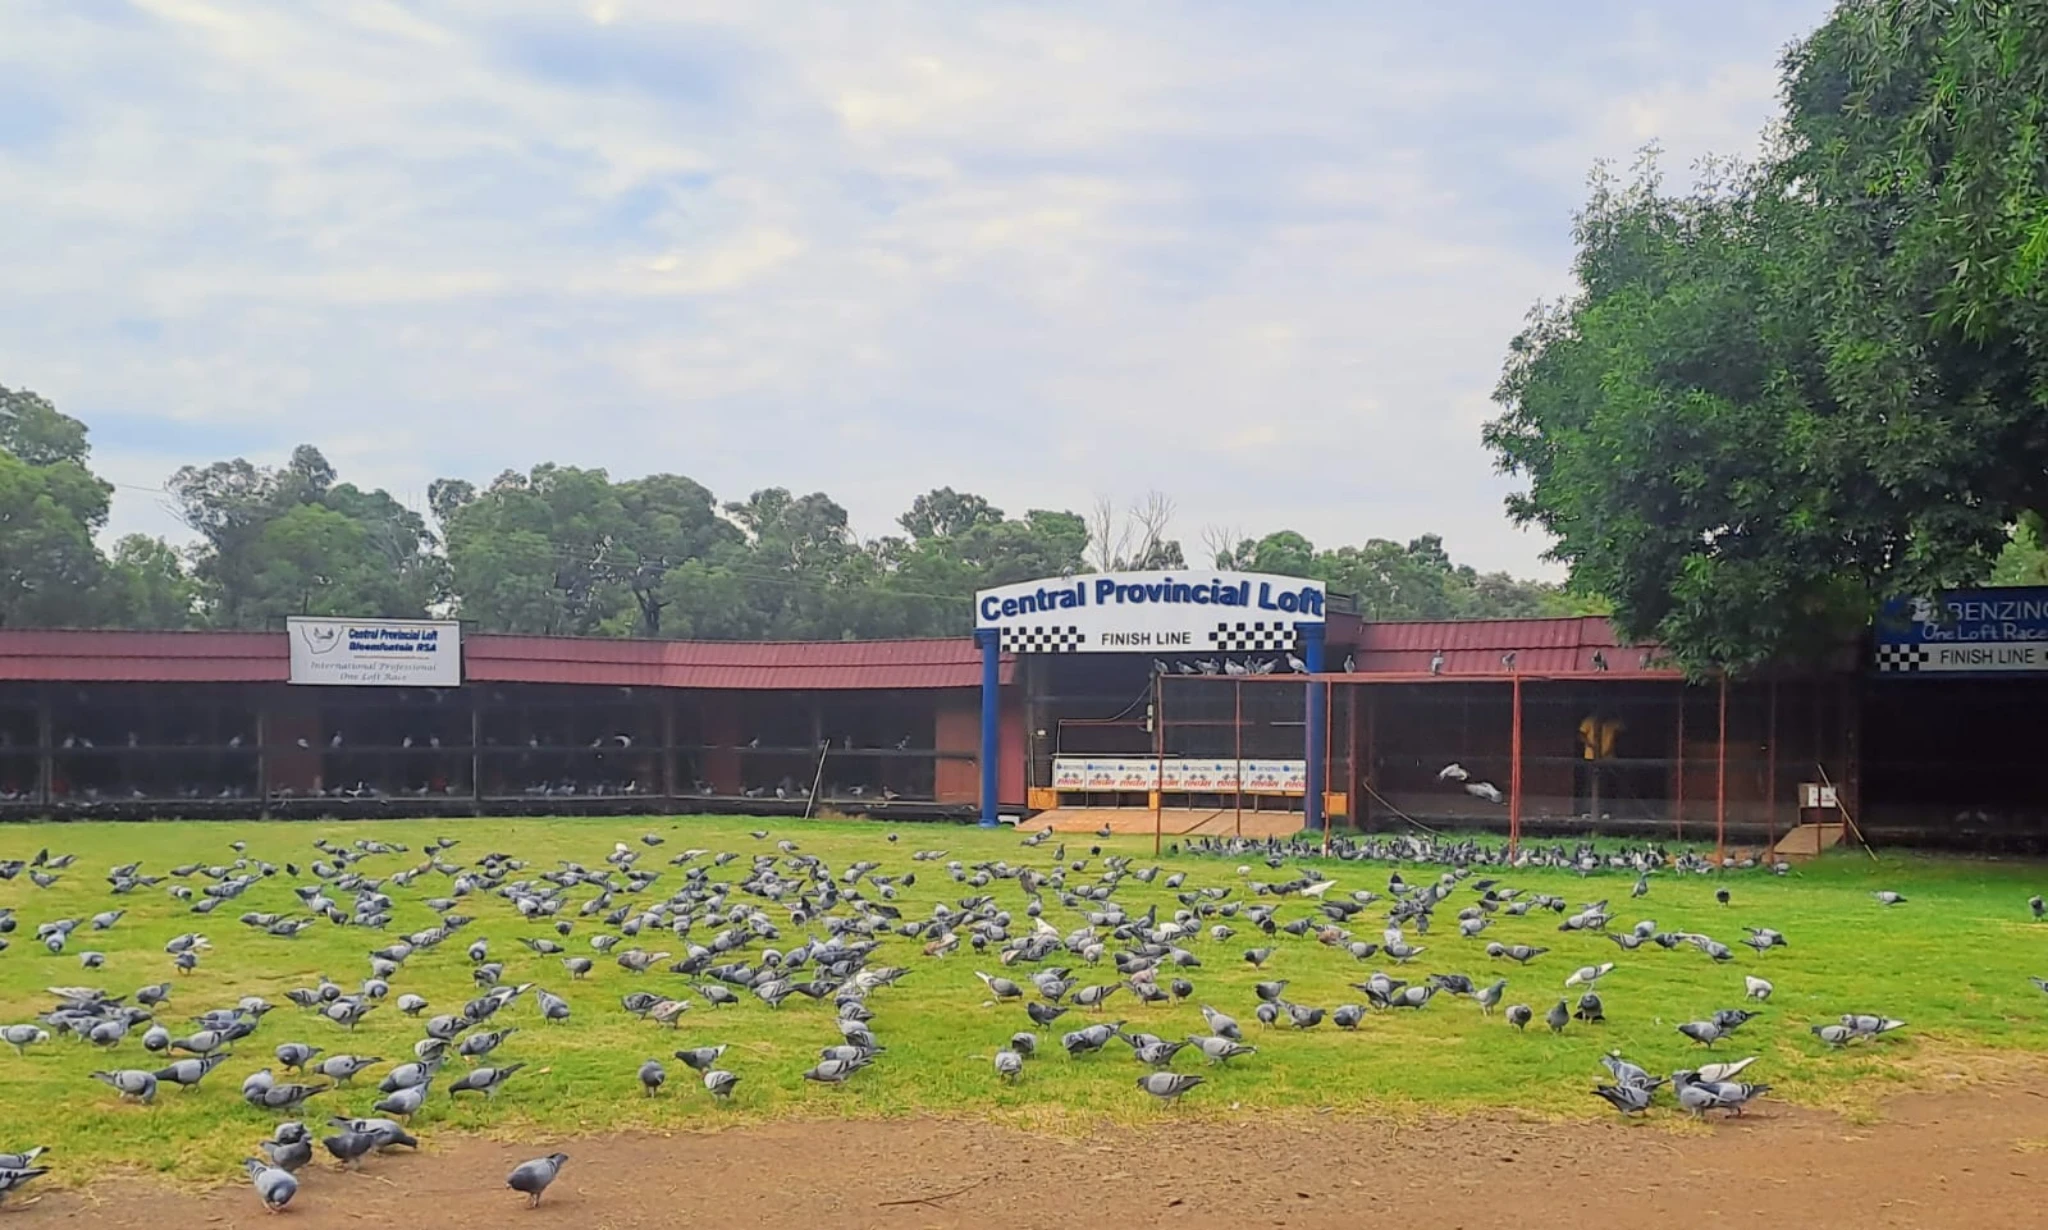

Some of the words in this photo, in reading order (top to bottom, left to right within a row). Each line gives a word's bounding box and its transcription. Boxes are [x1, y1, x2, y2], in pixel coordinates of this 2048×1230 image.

[980, 582, 1085, 621] Central
[1095, 578, 1250, 607] Provincial
[1258, 583, 1324, 617] Loft
[348, 628, 379, 639] Central
[380, 628, 420, 640] Provincial
[421, 630, 438, 641] Loft
[1923, 622, 1955, 640] One
[1957, 625, 1999, 640] Loft
[2003, 622, 2048, 640] Race
[1101, 633, 1151, 646] FINISH
[1157, 632, 1191, 645] LINE
[416, 642, 437, 652] RSA
[1940, 649, 1993, 665] FINISH
[1998, 648, 2036, 664] LINE
[310, 661, 376, 670] International
